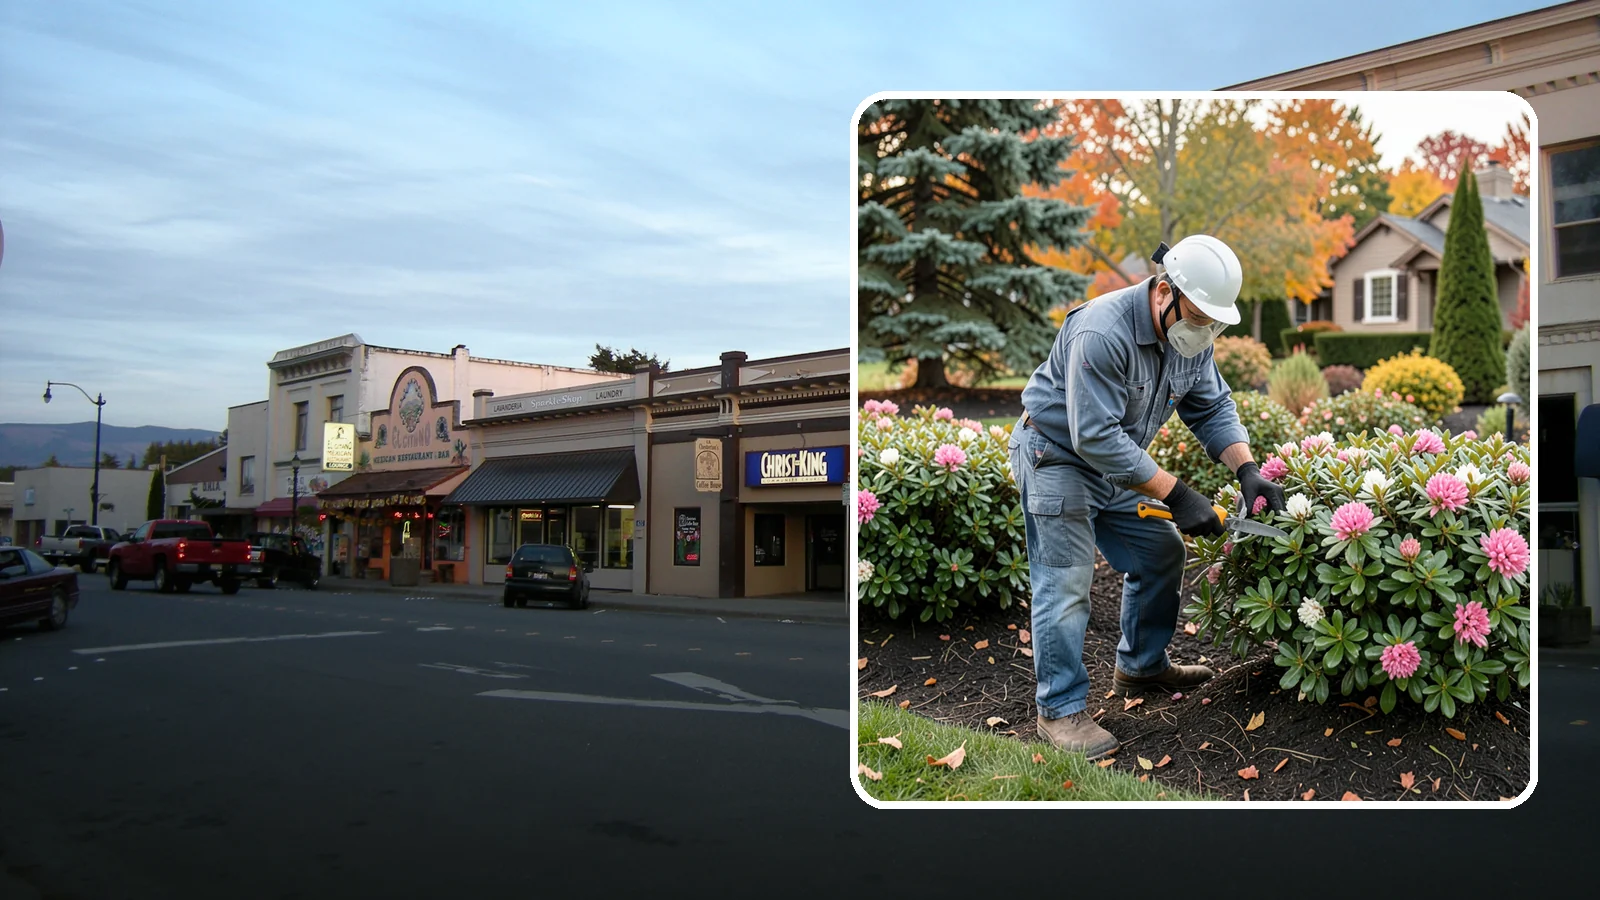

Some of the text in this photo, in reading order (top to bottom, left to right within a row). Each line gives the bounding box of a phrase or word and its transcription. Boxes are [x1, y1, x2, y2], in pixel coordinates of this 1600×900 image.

[562, 394, 582, 405] Shop
[595, 389, 623, 399] LAUNDRY
[493, 402, 522, 412] LAVANDERIA
[373, 454, 396, 464] MEXICAN
[397, 451, 434, 462] RESTAURANT
[438, 450, 450, 459] BAR
[761, 450, 828, 478] CHRIST KING
